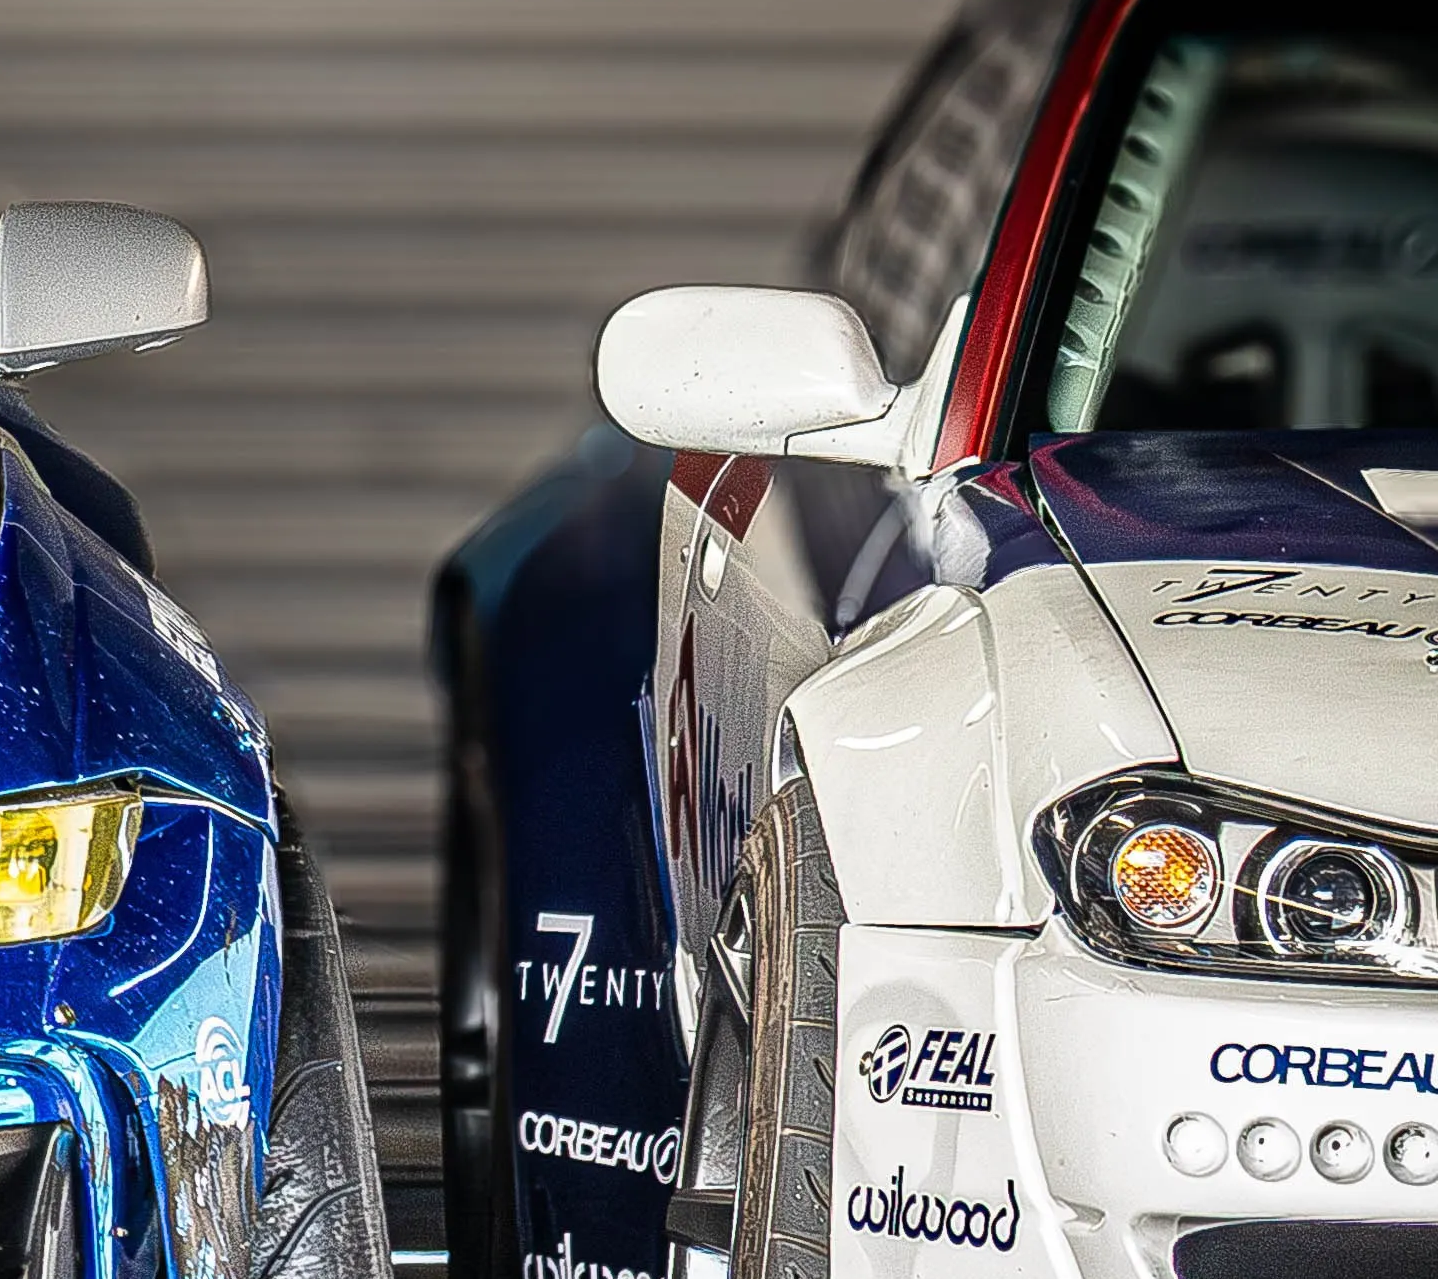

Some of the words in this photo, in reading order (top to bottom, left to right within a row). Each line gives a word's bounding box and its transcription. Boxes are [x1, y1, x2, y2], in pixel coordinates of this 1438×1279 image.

[1153, 611, 1427, 639] CORBEAU
[909, 1029, 997, 1087] FEAL
[905, 1087, 990, 1110] Suspension
[520, 1111, 656, 1173] CORBEAU
[847, 1165, 1021, 1252] wilwood
